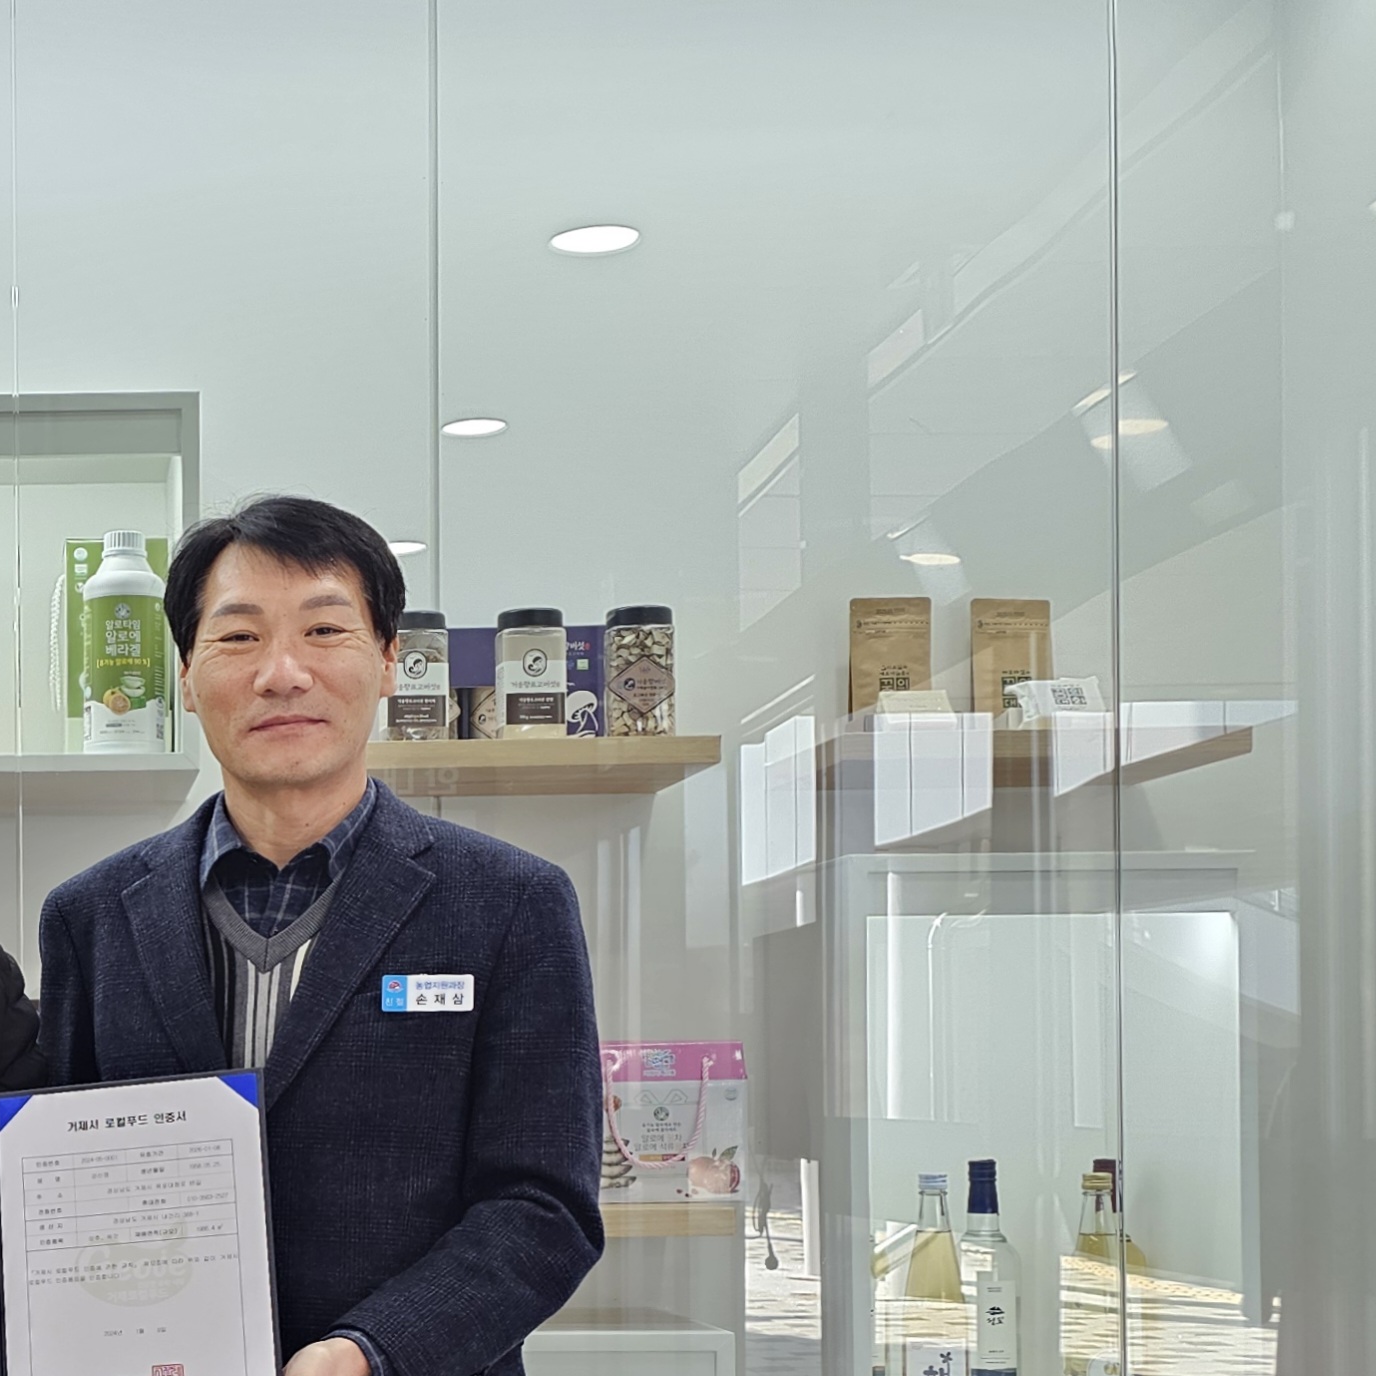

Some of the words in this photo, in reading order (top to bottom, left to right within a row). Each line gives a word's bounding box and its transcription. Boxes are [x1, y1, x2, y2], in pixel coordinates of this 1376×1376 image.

[105, 619, 141, 631] 알로타임
[105, 631, 141, 643] 알로에
[105, 644, 141, 657] 베라겔
[67, 1118, 99, 1132] 거제시
[105, 1114, 148, 1129] 로컬푸드
[153, 1110, 187, 1125] 인증서
